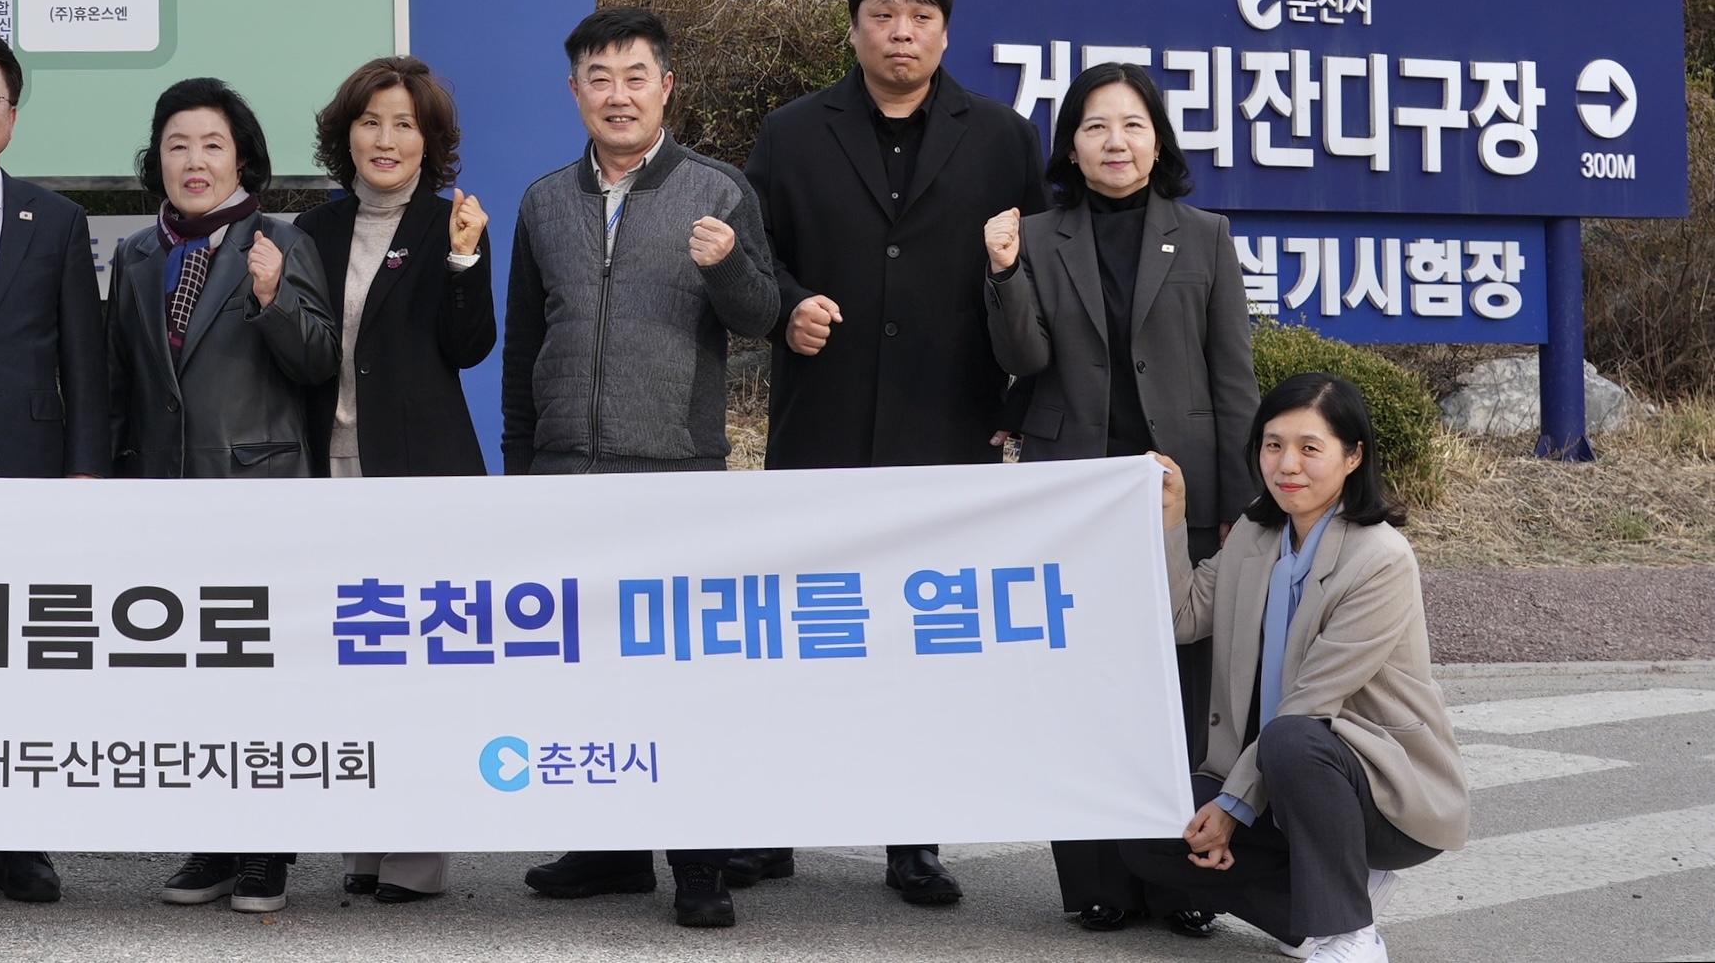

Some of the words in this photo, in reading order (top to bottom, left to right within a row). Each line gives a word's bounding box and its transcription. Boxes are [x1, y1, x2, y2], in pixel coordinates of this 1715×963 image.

[49, 5, 128, 23] (주)휴온스엔
[993, 40, 1547, 177] 거리잔디구장
[1580, 152, 1636, 180] 300M
[332, 578, 580, 666] 춘천의
[618, 572, 871, 662] 미래를
[903, 562, 1075, 656] 열다
[537, 741, 659, 785] 춘천시
